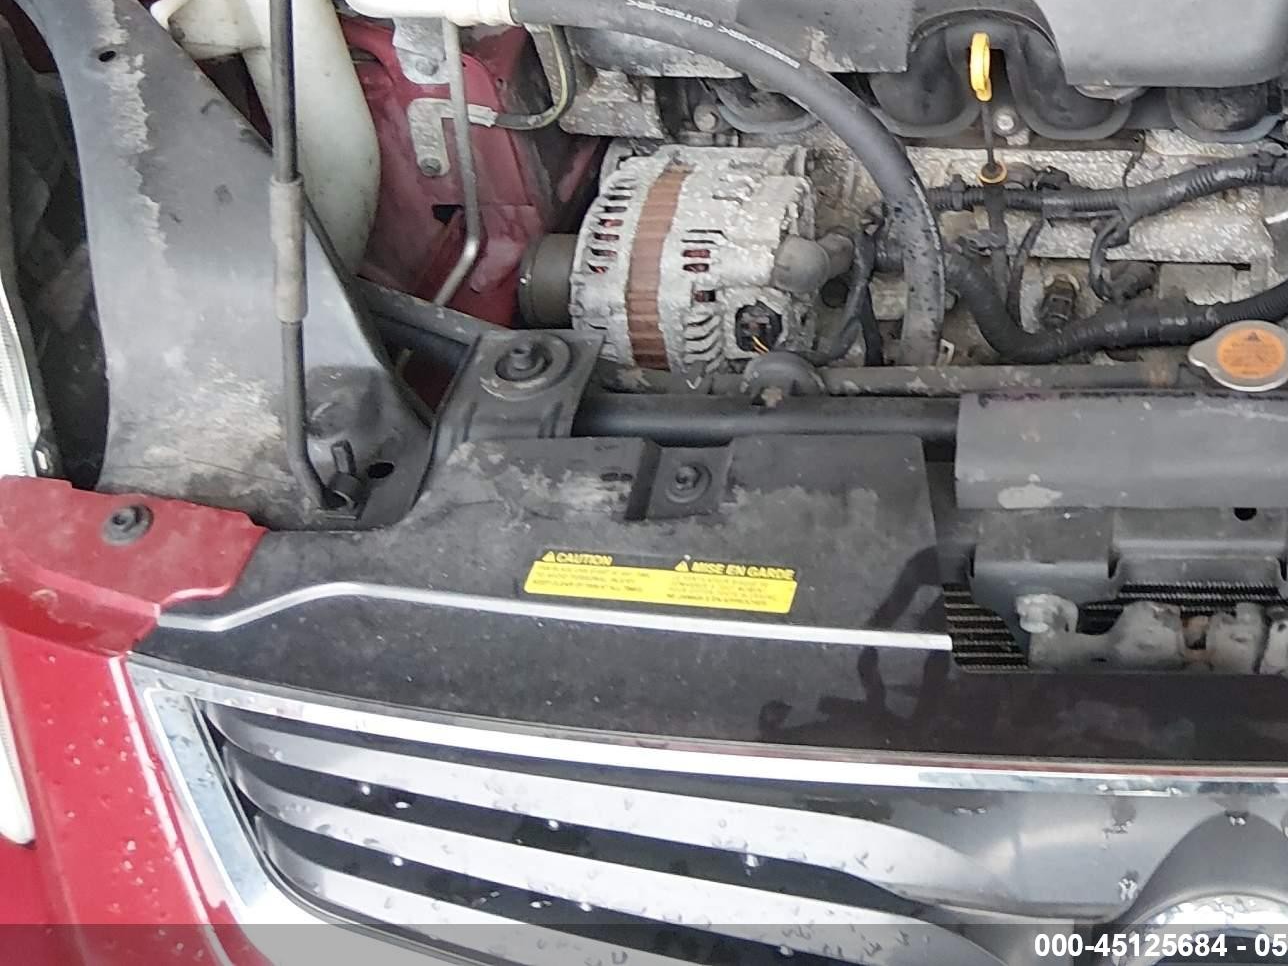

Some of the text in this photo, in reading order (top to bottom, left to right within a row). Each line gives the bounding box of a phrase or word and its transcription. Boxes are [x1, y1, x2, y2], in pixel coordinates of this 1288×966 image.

[556, 552, 613, 566] CAUTION
[691, 561, 796, 581] MISE EN GARDE
